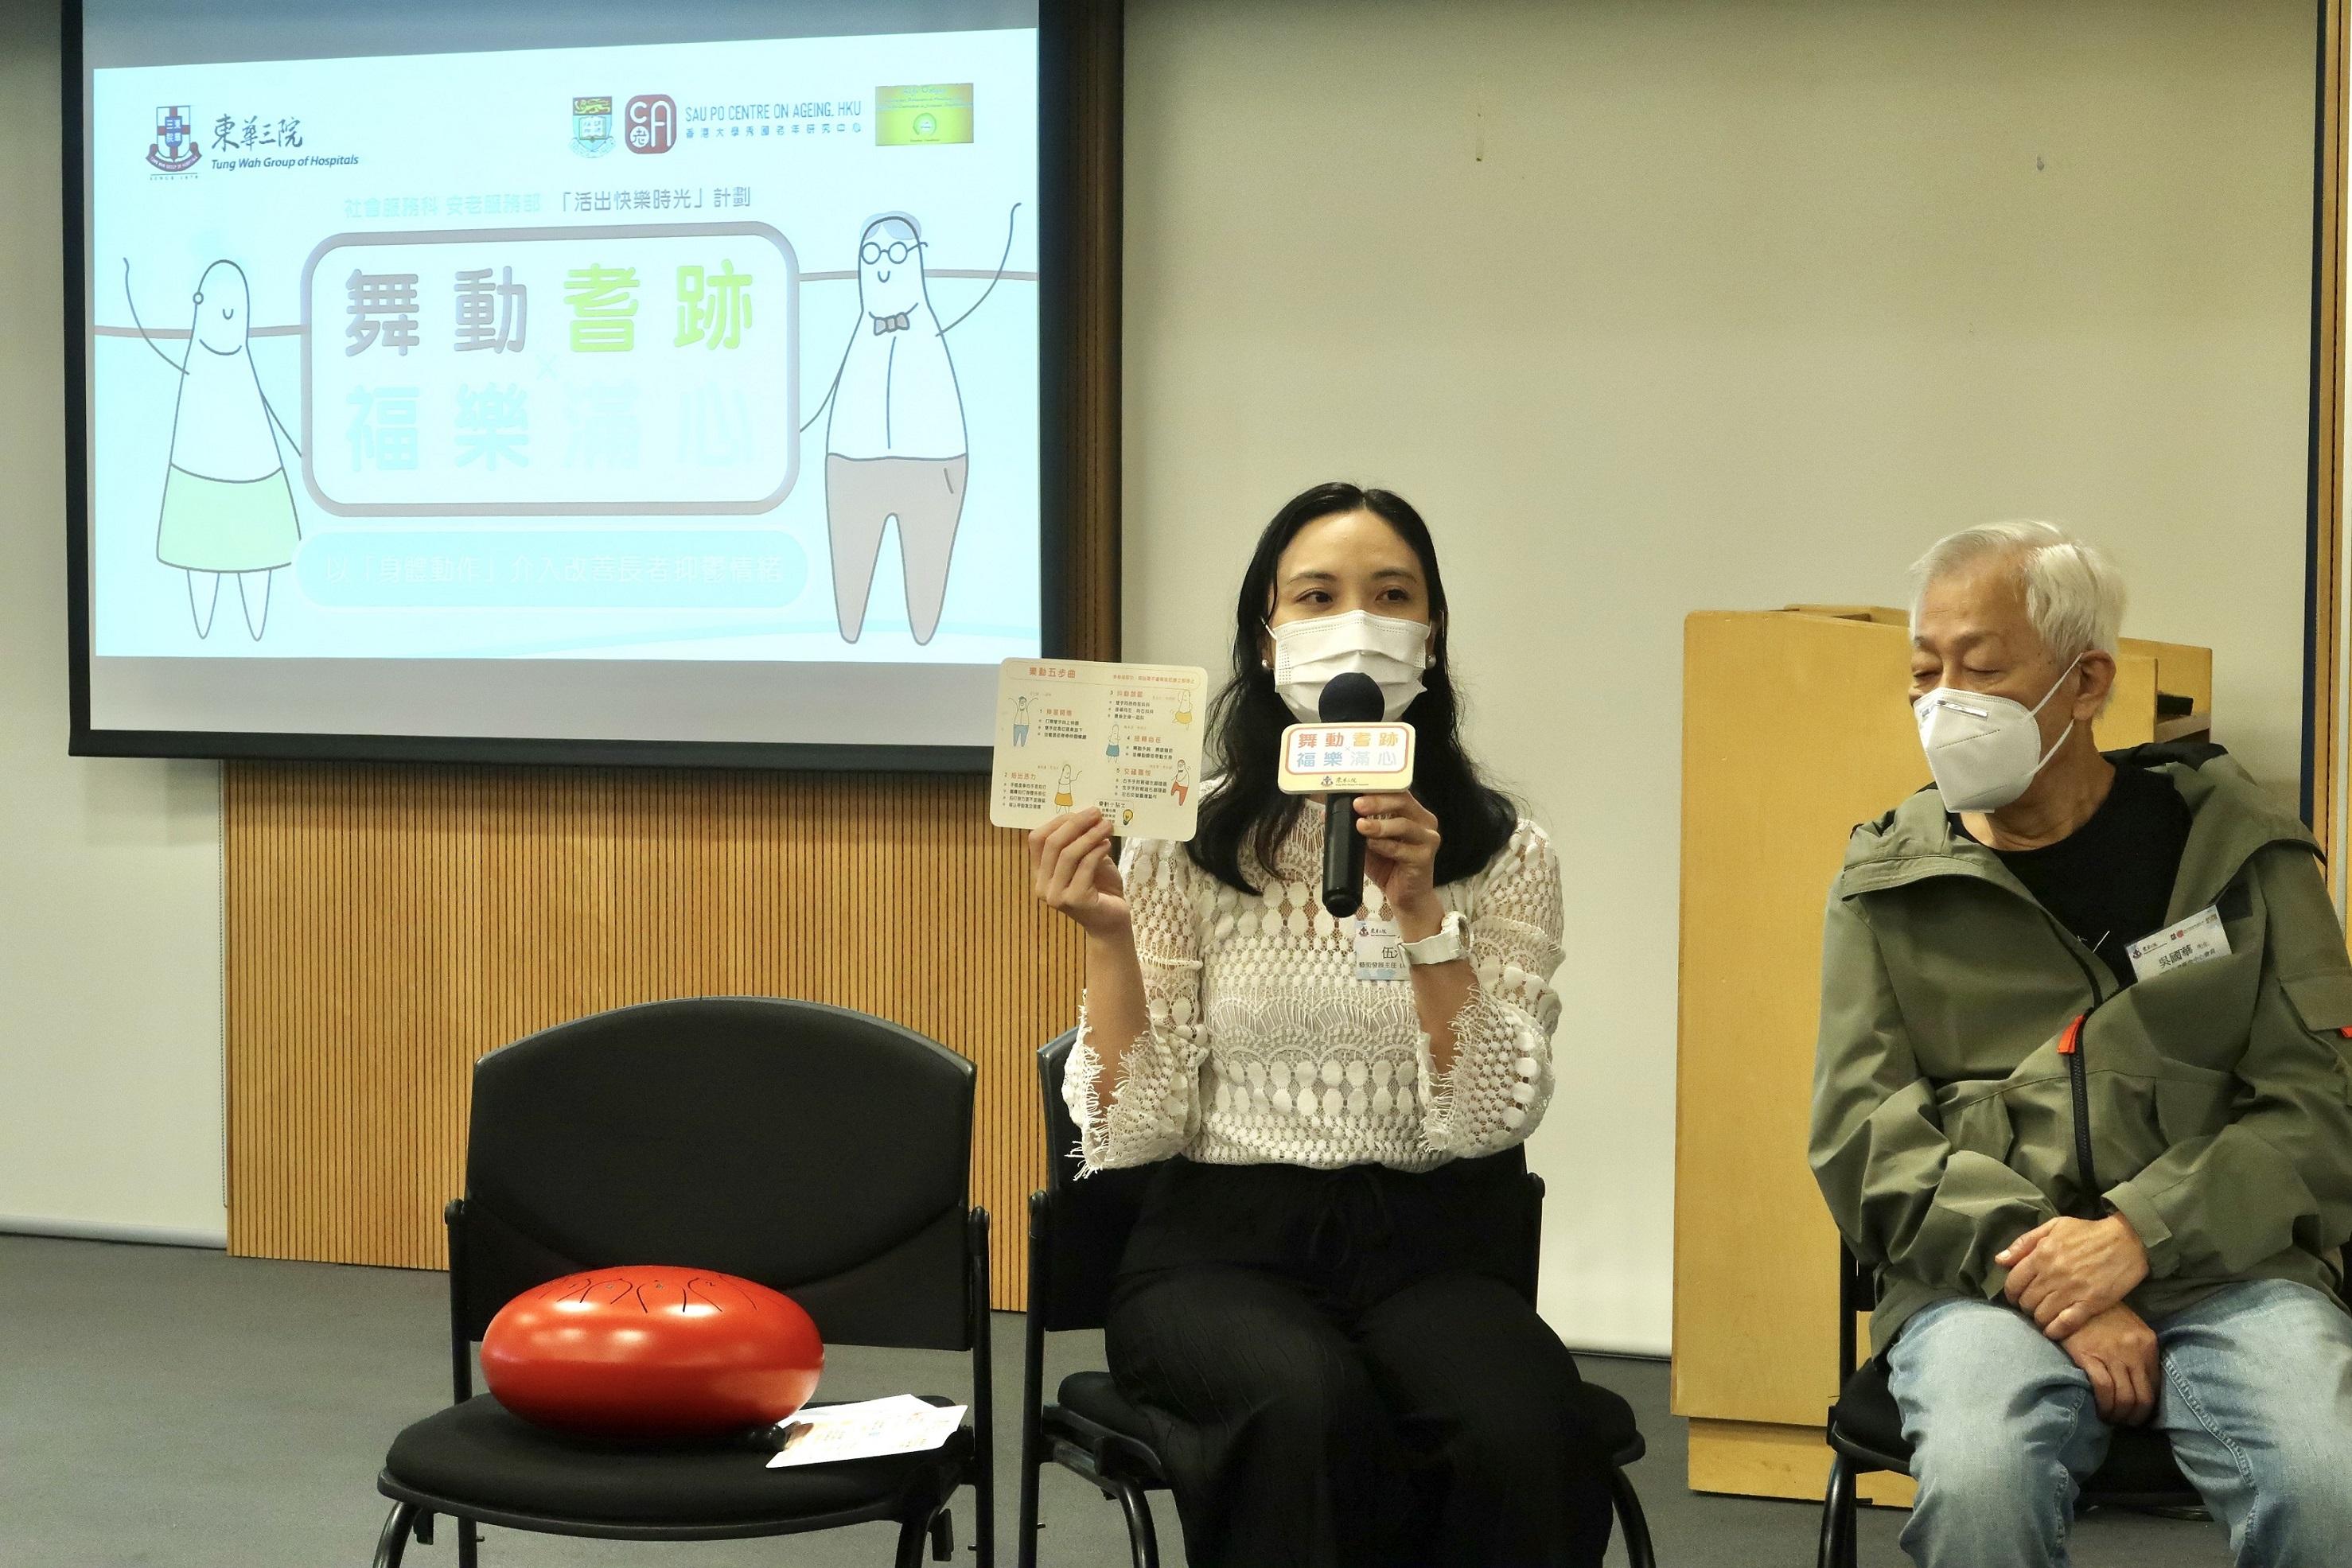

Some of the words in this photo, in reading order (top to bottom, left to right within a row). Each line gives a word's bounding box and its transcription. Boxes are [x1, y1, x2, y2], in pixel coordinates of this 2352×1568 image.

[685, 106, 707, 122] SAU
[710, 105, 725, 121] PO
[728, 103, 770, 120] CENTRE
[773, 103, 789, 119] ON
[838, 100, 862, 116] HKU
[211, 113, 303, 153] 東華三院
[212, 159, 236, 172] Tung
[239, 158, 262, 169] Wah
[263, 157, 295, 169] Group
[298, 155, 310, 166] of
[310, 154, 360, 168] Hospitals
[345, 259, 753, 357] 舞動耆跡
[345, 382, 755, 473] 福樂滿心
[1297, 731, 1399, 749] 舞動耆跡
[1296, 750, 1397, 768] 福樂滿心
[2159, 944, 2194, 969] 吳國華
